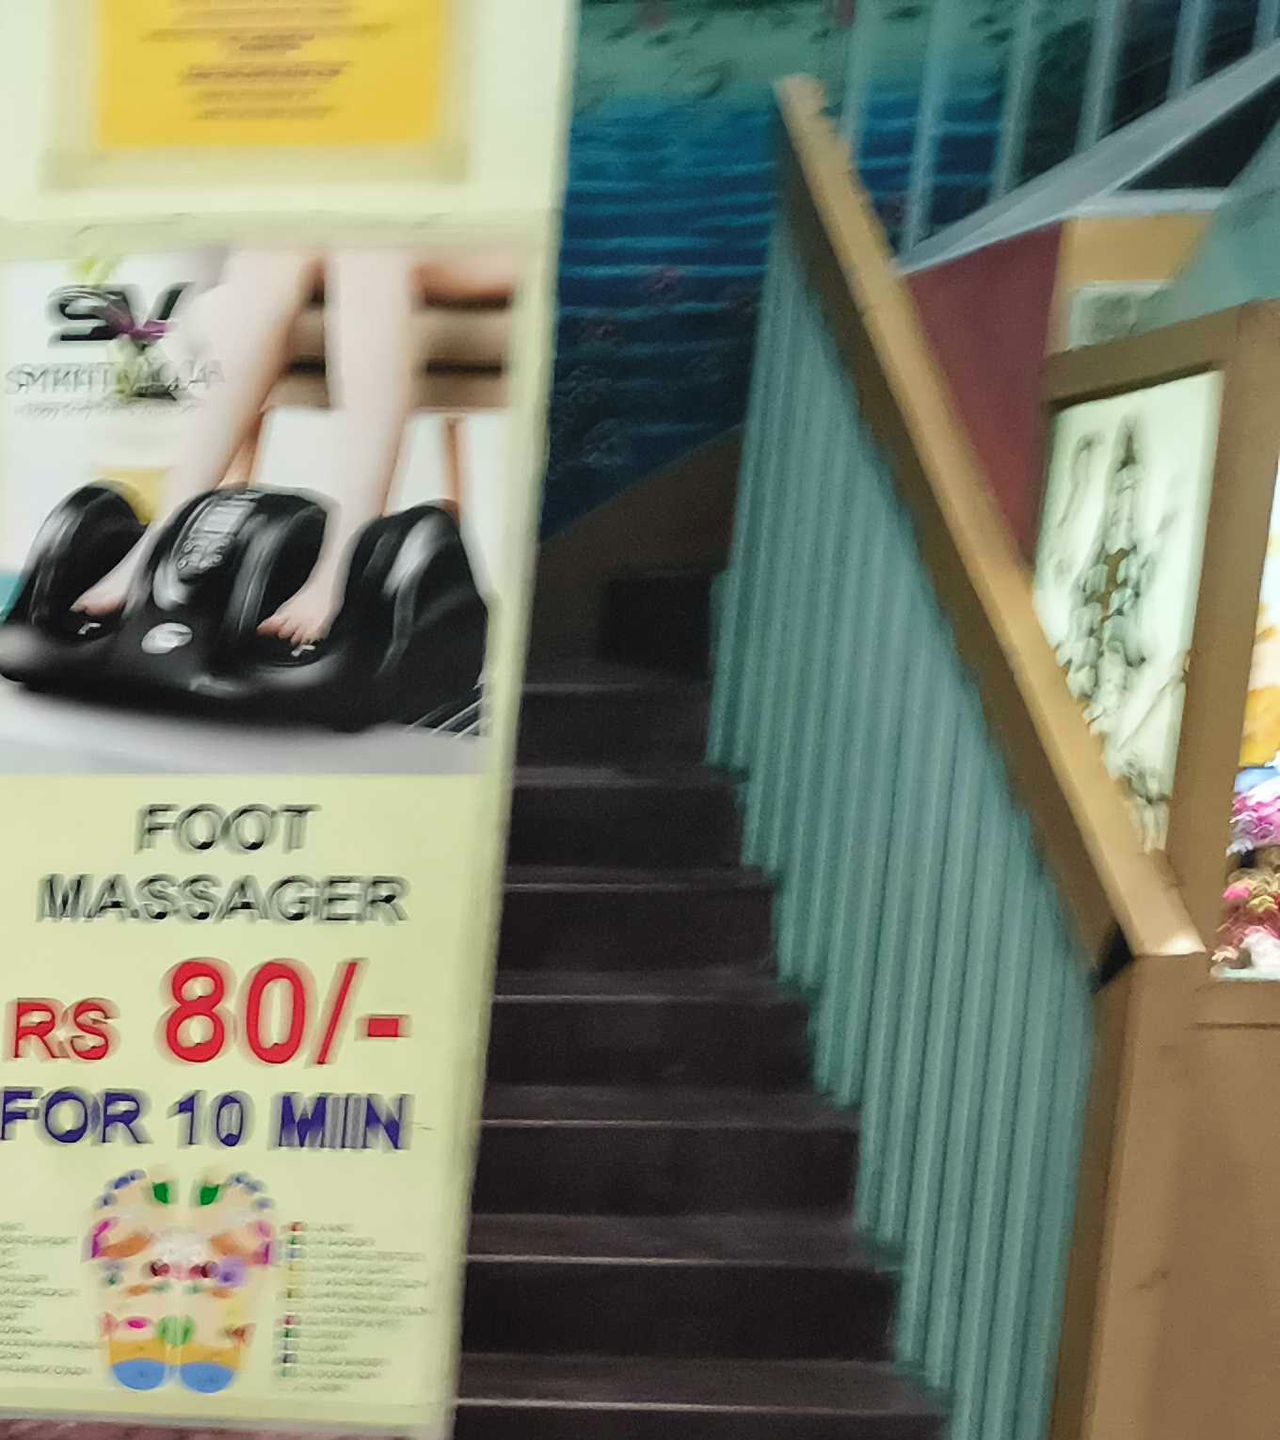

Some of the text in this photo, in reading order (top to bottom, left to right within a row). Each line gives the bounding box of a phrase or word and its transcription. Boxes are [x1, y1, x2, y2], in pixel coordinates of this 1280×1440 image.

[137, 802, 321, 852] FOOT
[37, 873, 412, 923] MASSAGER
[6, 957, 412, 1065] RS 80/-
[168, 1089, 252, 1147] 10
[273, 1091, 413, 1150] MIN
